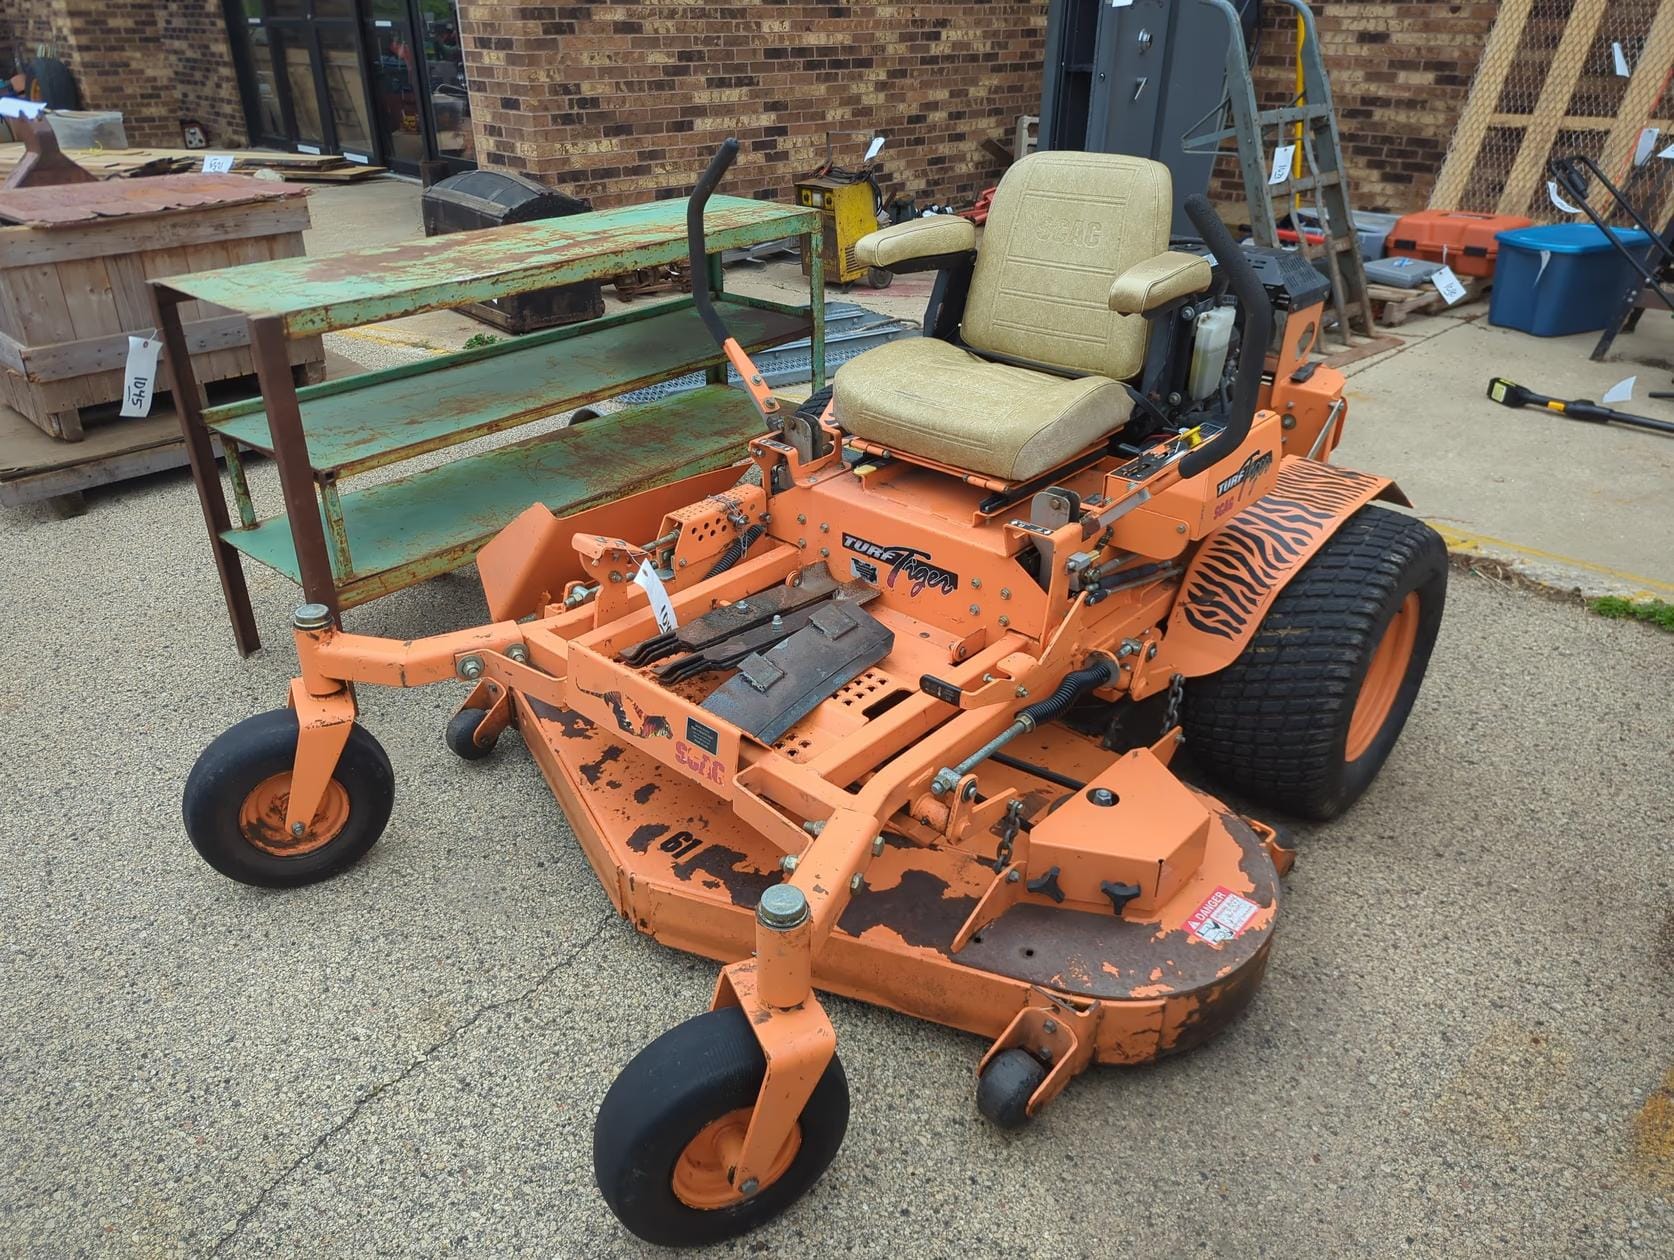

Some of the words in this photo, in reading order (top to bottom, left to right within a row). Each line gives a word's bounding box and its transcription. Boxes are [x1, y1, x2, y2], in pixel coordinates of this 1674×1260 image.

[131, 376, 148, 409] 1045
[1218, 470, 1245, 496] TURF
[843, 535, 896, 561] TURF
[886, 546, 955, 598] Tiger
[660, 830, 704, 859] 61
[1195, 891, 1226, 920] DANGER
